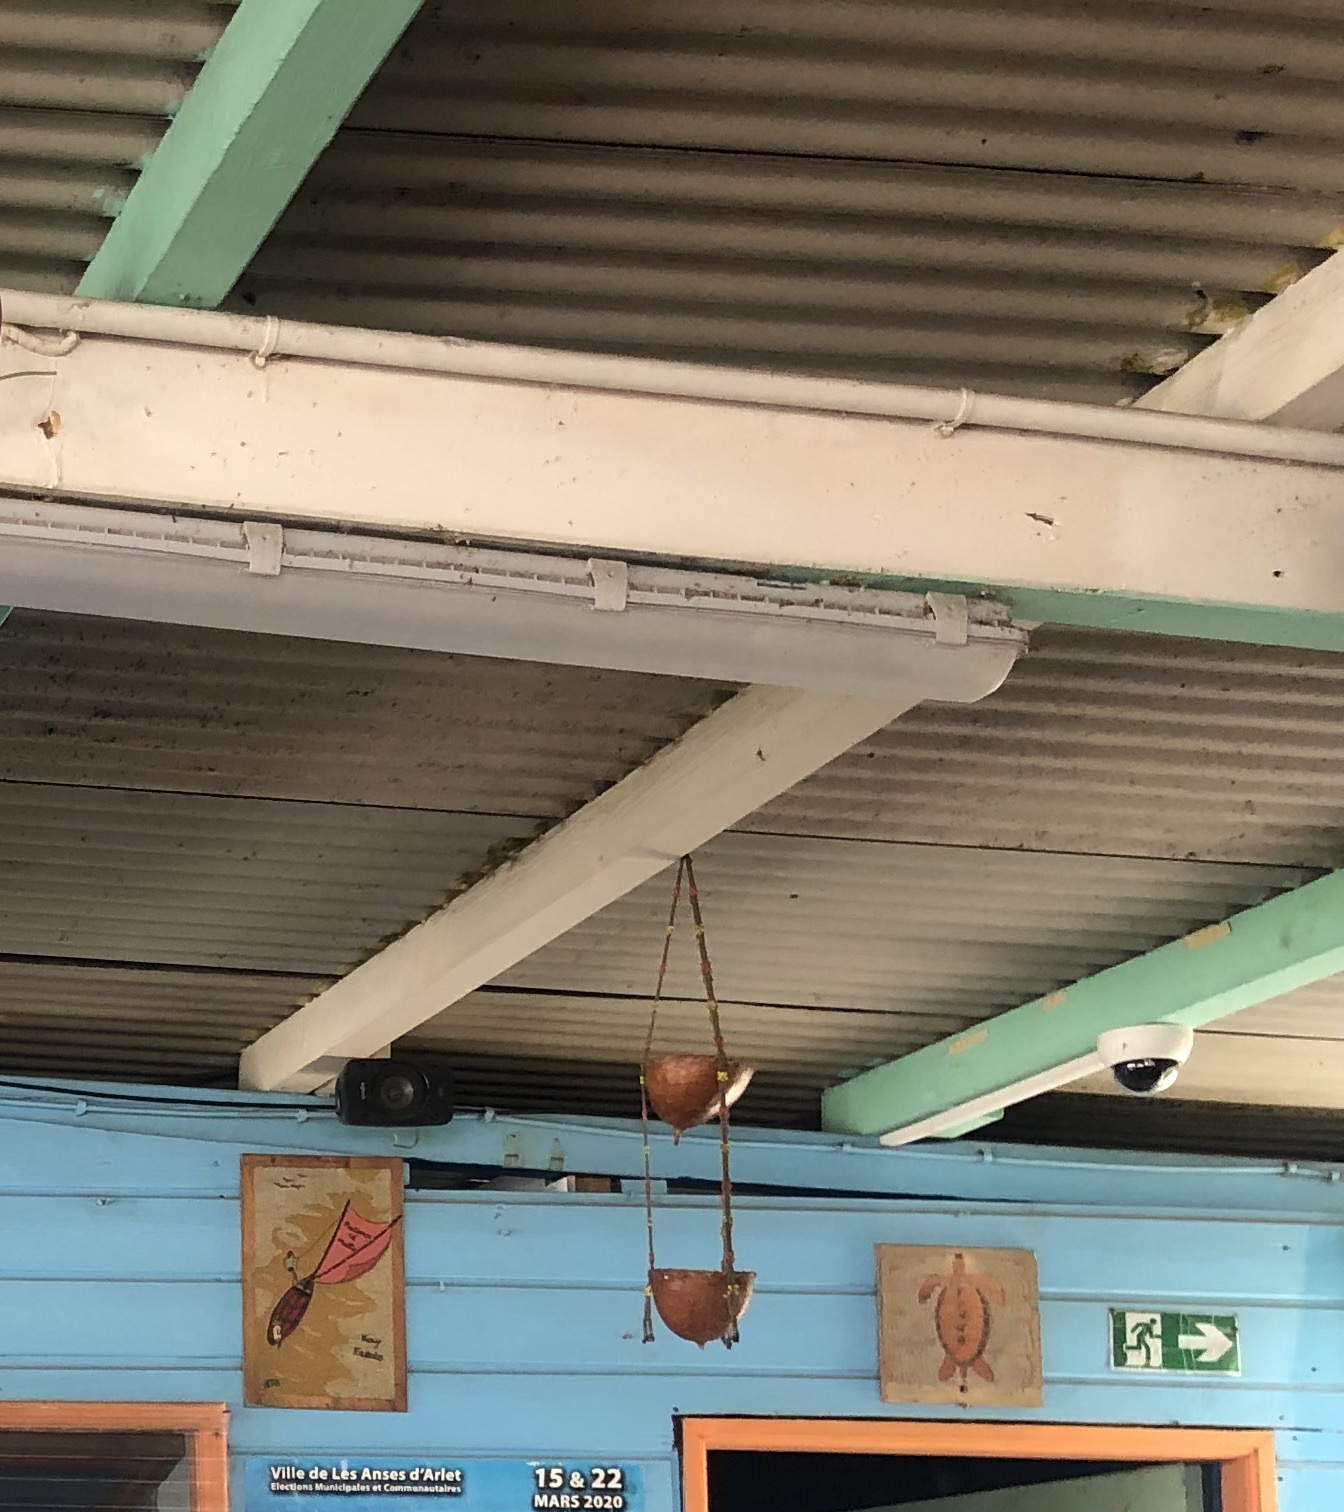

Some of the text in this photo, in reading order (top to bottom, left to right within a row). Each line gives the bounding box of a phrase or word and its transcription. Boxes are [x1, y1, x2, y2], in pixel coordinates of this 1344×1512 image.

[270, 1466, 305, 1481] Ville
[308, 1466, 329, 1481] de
[360, 1467, 407, 1482] Anses
[535, 1468, 622, 1488] 15 & 22
[314, 1482, 371, 1494] Municipales
[372, 1484, 382, 1492] et
[383, 1483, 462, 1493] Communautaires
[534, 1494, 623, 1509] MARS 2020
